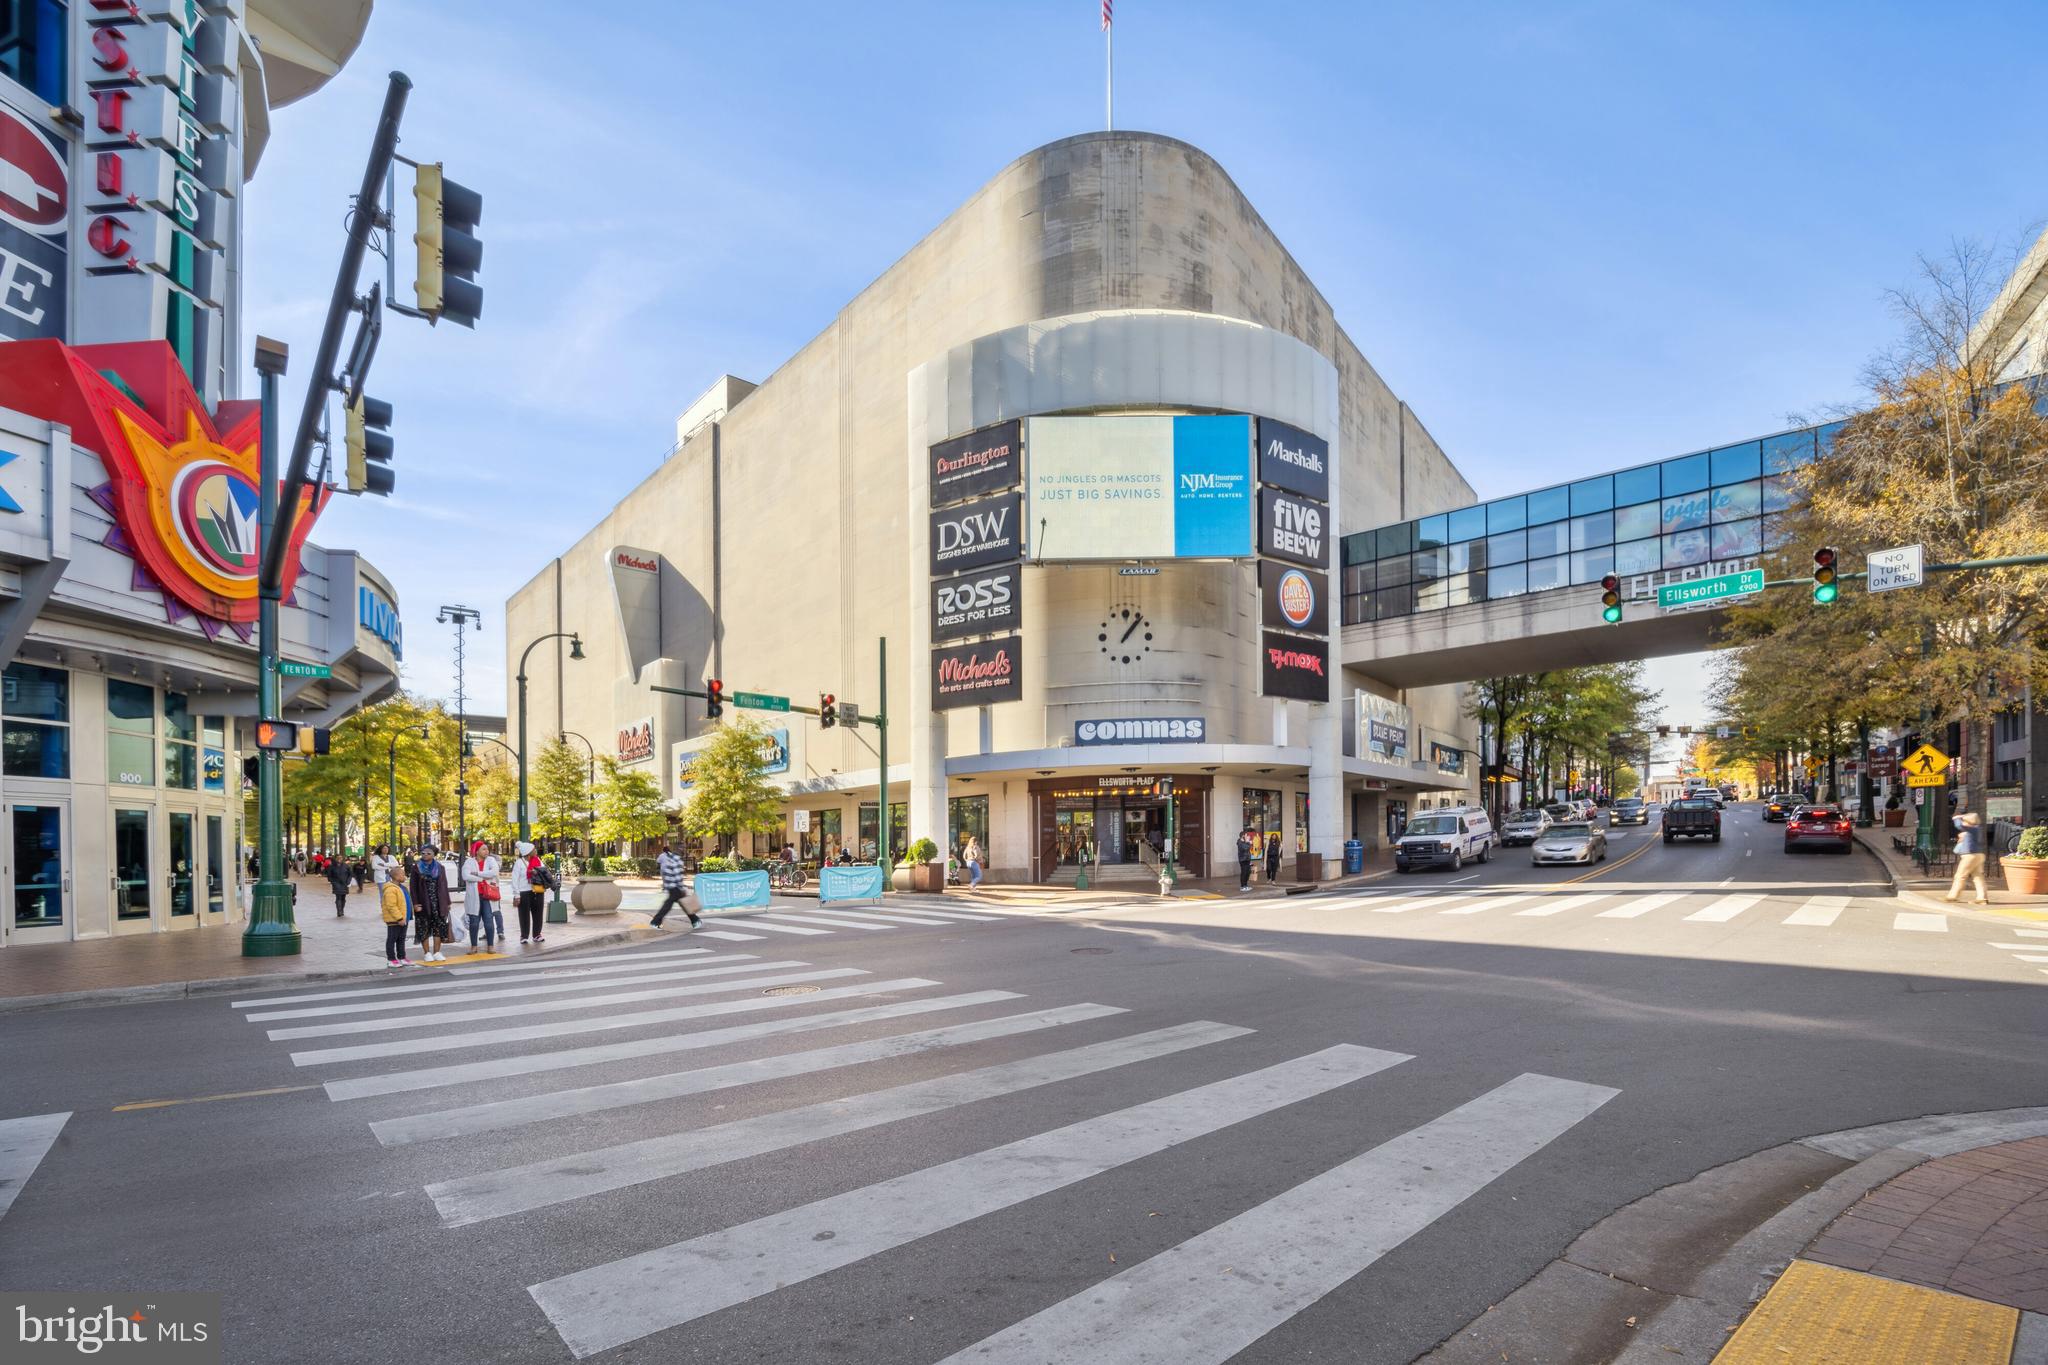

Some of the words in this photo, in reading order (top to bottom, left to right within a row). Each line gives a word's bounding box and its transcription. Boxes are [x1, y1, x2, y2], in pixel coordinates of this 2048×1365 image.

[88, 0, 132, 260] STIC
[937, 445, 1010, 475] Burlington
[1268, 440, 1322, 473] Marshalls
[1057, 475, 1097, 483] JINGLES
[1101, 475, 1113, 483] OR
[1181, 474, 1215, 492] NJM
[1215, 482, 1233, 490] Group
[1040, 489, 1072, 500] JUST
[1078, 489, 1099, 499] BIG
[1274, 499, 1320, 537] five
[937, 507, 1009, 552] DSW
[937, 548, 961, 560] DESIGNER
[962, 545, 976, 555] SHOE
[976, 537, 1010, 552] WAREHOUSE
[1885, 554, 1903, 564] NO
[1880, 563, 1910, 575] TURN
[1666, 582, 1727, 601] Ellsworth
[1740, 574, 1752, 583] Dr
[1873, 577, 1887, 586] ON
[1894, 573, 1916, 583] RED
[938, 575, 1011, 614] ROSS
[1284, 584, 1302, 598] DAVE
[1302, 585, 1309, 598] &
[938, 613, 965, 627] DRESS
[968, 609, 985, 620] FOR
[988, 605, 1011, 617] LESS
[284, 664, 317, 675] FENTON
[939, 650, 1011, 683] Michaels
[951, 683, 961, 692] arts
[963, 681, 974, 689] and
[975, 679, 992, 688] crafts
[994, 678, 1010, 686] store
[741, 695, 764, 706] Fenton
[1078, 720, 1203, 740] commas
[120, 773, 141, 783] 900
[732, 881, 746, 891] Do
